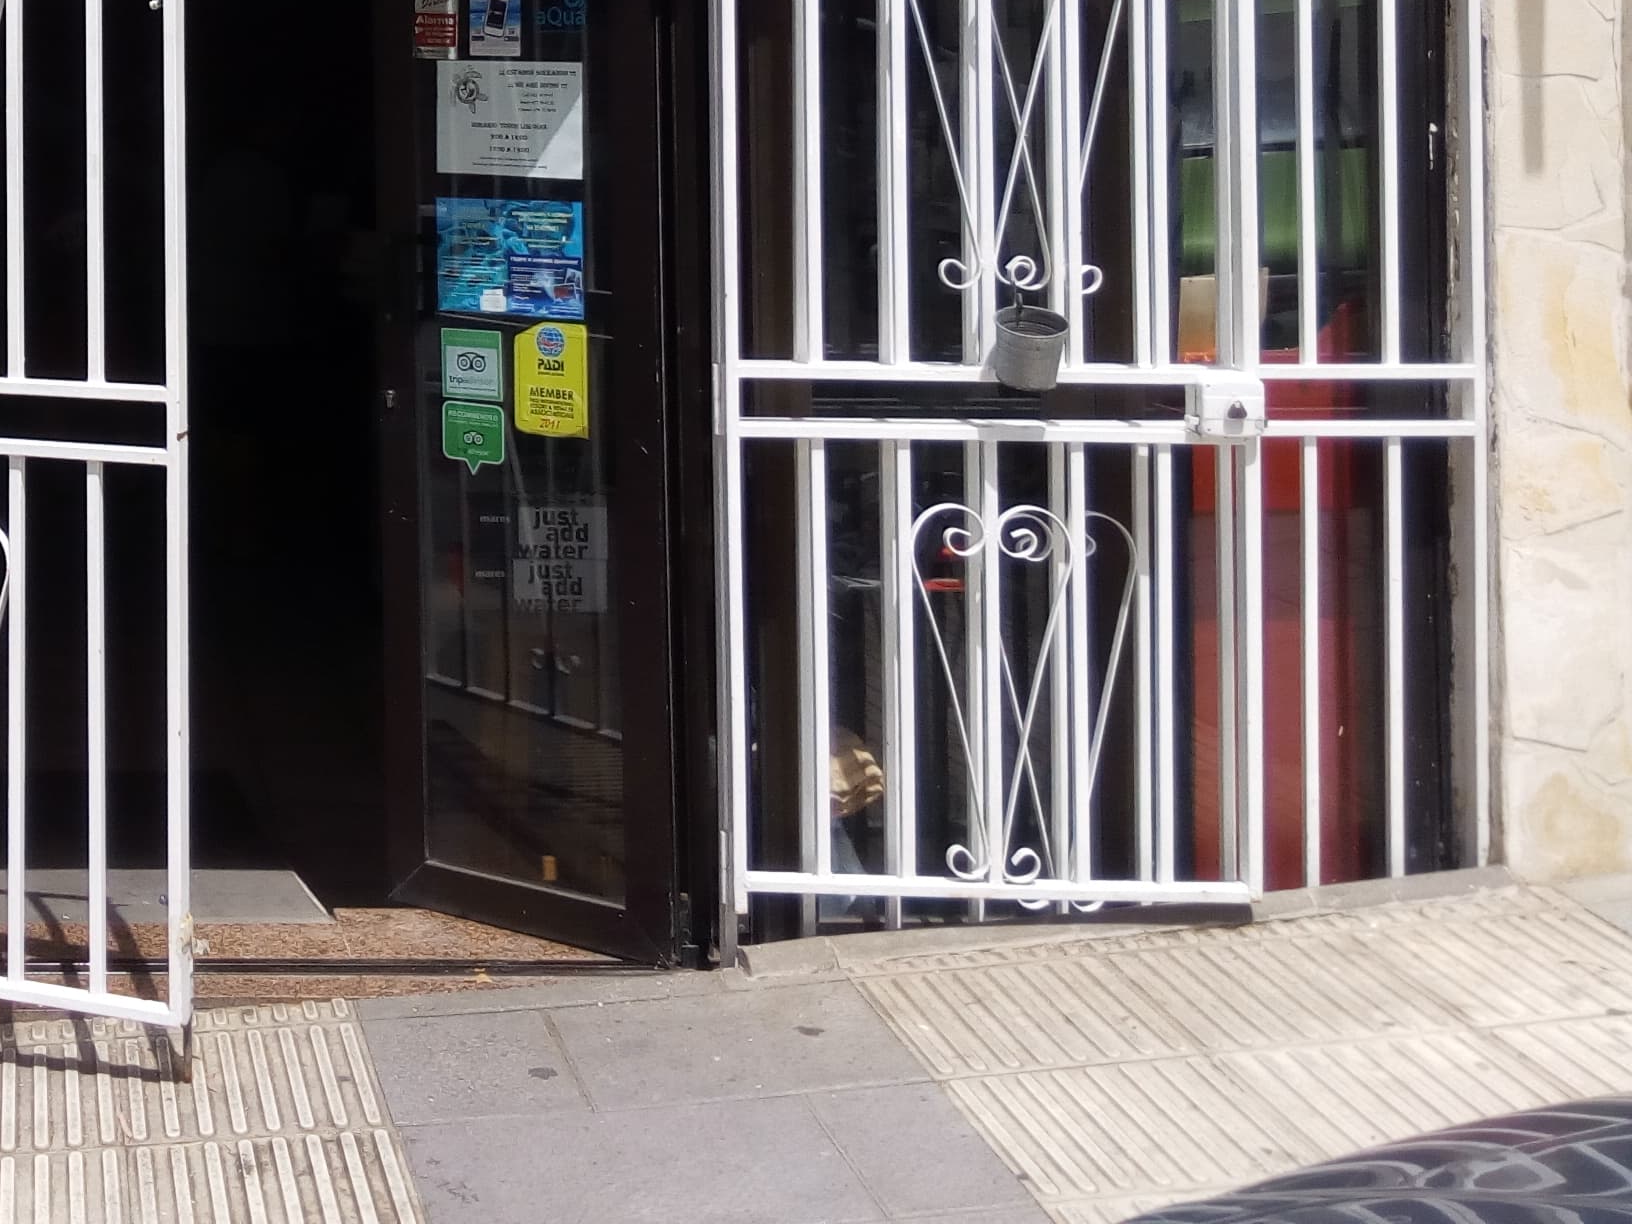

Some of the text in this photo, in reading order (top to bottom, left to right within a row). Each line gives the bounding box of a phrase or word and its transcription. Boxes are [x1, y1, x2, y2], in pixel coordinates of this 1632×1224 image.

[538, 358, 565, 371] PADI
[530, 387, 574, 401] MEMBER
[534, 506, 579, 529] just
[546, 523, 588, 543] add
[519, 543, 588, 559] water
[528, 560, 573, 584] just
[542, 577, 583, 596] add
